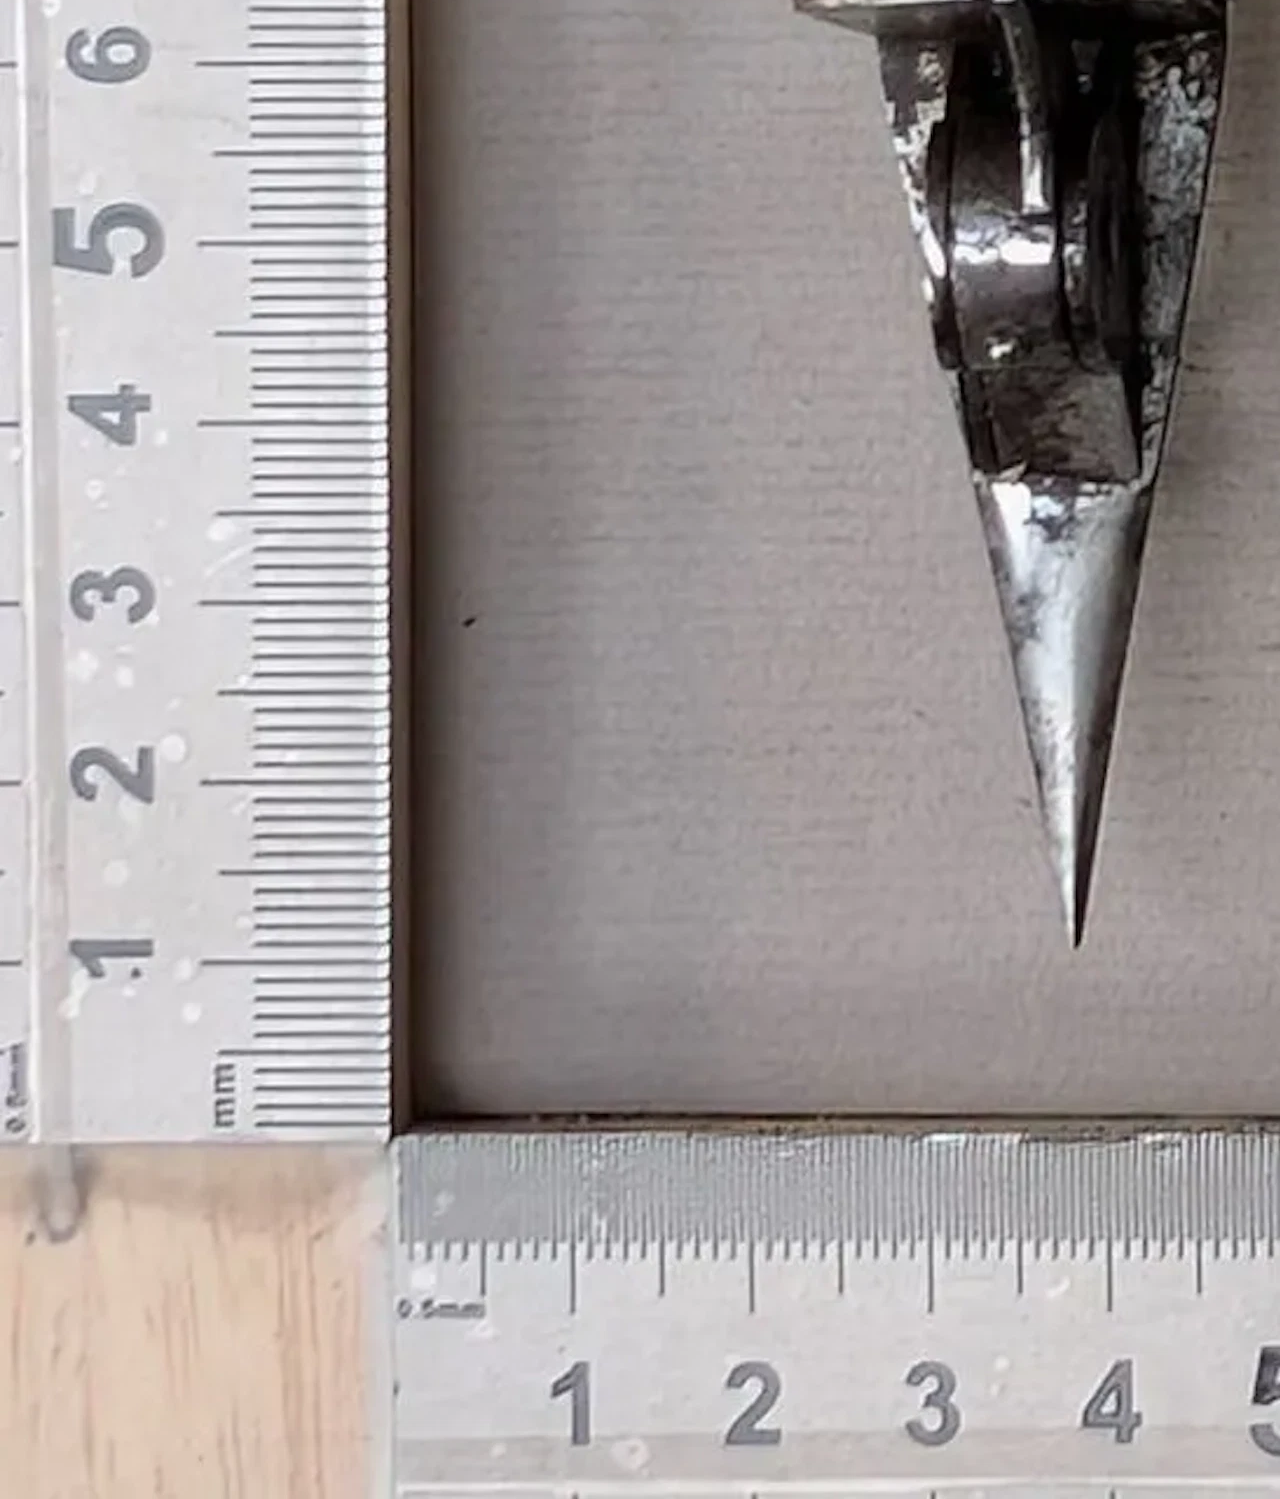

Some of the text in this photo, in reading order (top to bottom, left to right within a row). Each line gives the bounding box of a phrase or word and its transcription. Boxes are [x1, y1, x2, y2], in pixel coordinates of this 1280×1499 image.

[64, 25, 152, 85] 6
[50, 202, 165, 279] 5
[66, 383, 152, 447] 4
[68, 566, 155, 625] 3
[69, 746, 155, 805] 2
[67, 938, 155, 980] 1
[213, 1062, 236, 1129] mm
[549, 1360, 591, 1447] 1
[723, 1361, 782, 1448] 2
[904, 1360, 961, 1448] 3
[1079, 1358, 1143, 1445] 4
